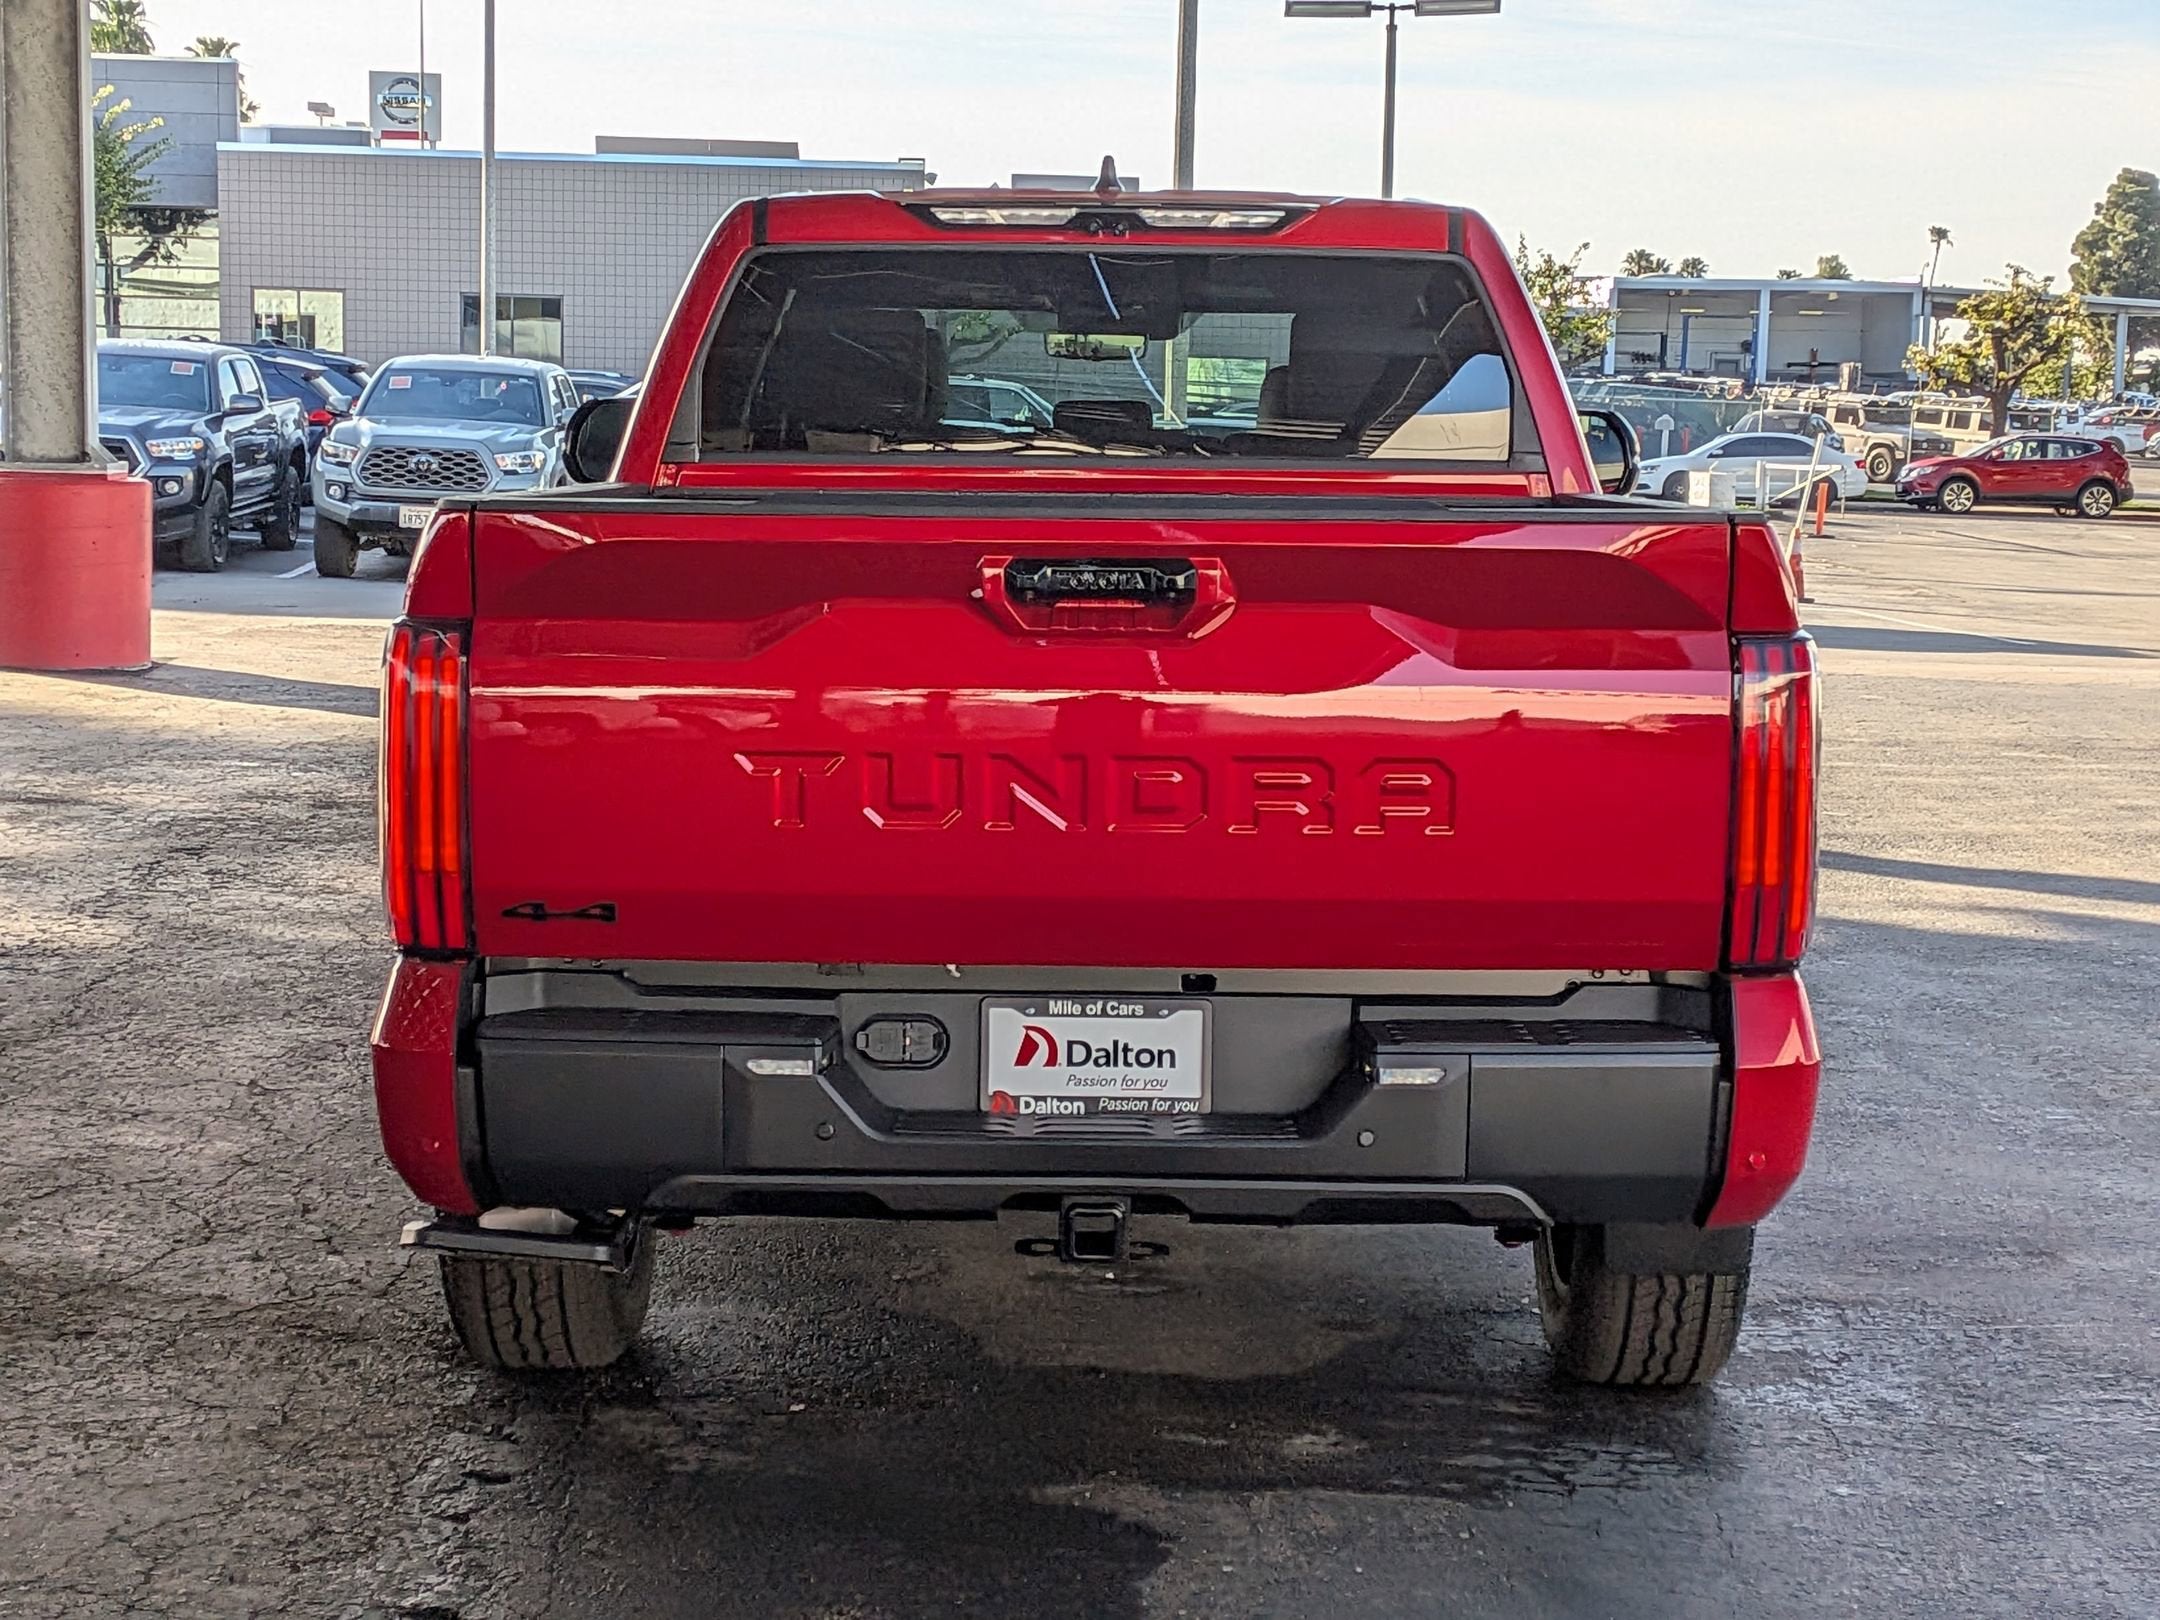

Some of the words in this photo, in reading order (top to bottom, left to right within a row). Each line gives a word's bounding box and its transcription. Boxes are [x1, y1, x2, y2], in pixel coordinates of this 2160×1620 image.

[734, 750, 1456, 834] TUNDRA
[1049, 1001, 1082, 1015] Mile
[1086, 1001, 1103, 1016] of
[1106, 1001, 1144, 1016] Cars
[1066, 1039, 1176, 1068] Dalton
[1066, 1074, 1117, 1088] Passion
[1120, 1074, 1140, 1089] for
[1142, 1078, 1168, 1089] you
[1019, 1097, 1086, 1115] Dalton
[1098, 1098, 1149, 1112] Passion
[1151, 1098, 1170, 1113] for
[1172, 1101, 1199, 1115] you
